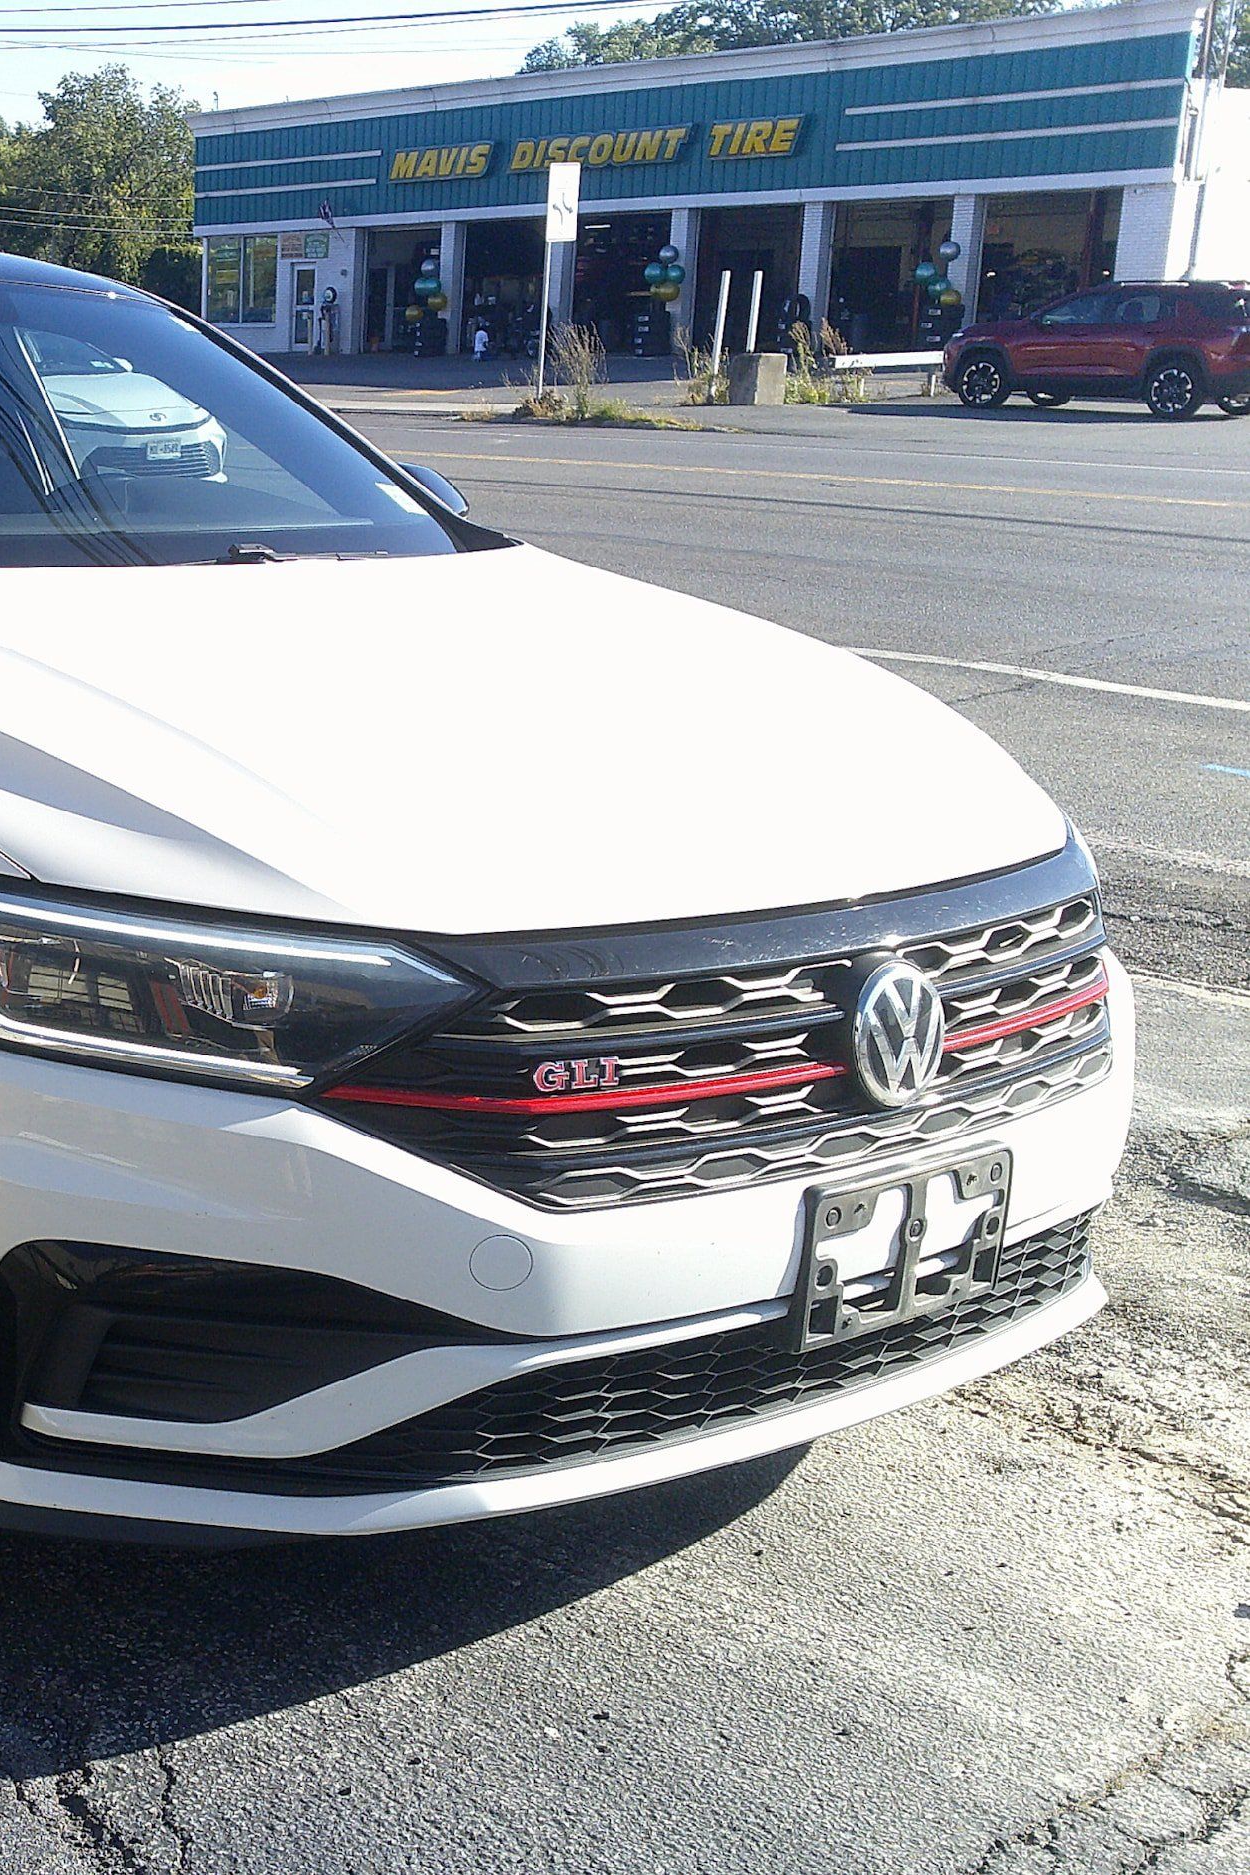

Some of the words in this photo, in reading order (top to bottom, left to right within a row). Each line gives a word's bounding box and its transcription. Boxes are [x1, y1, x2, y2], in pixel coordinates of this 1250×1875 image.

[390, 145, 490, 180] MAVIS
[511, 128, 686, 170] DISCOUNT
[709, 119, 799, 156] TIRE
[533, 1056, 619, 1092] GLI
